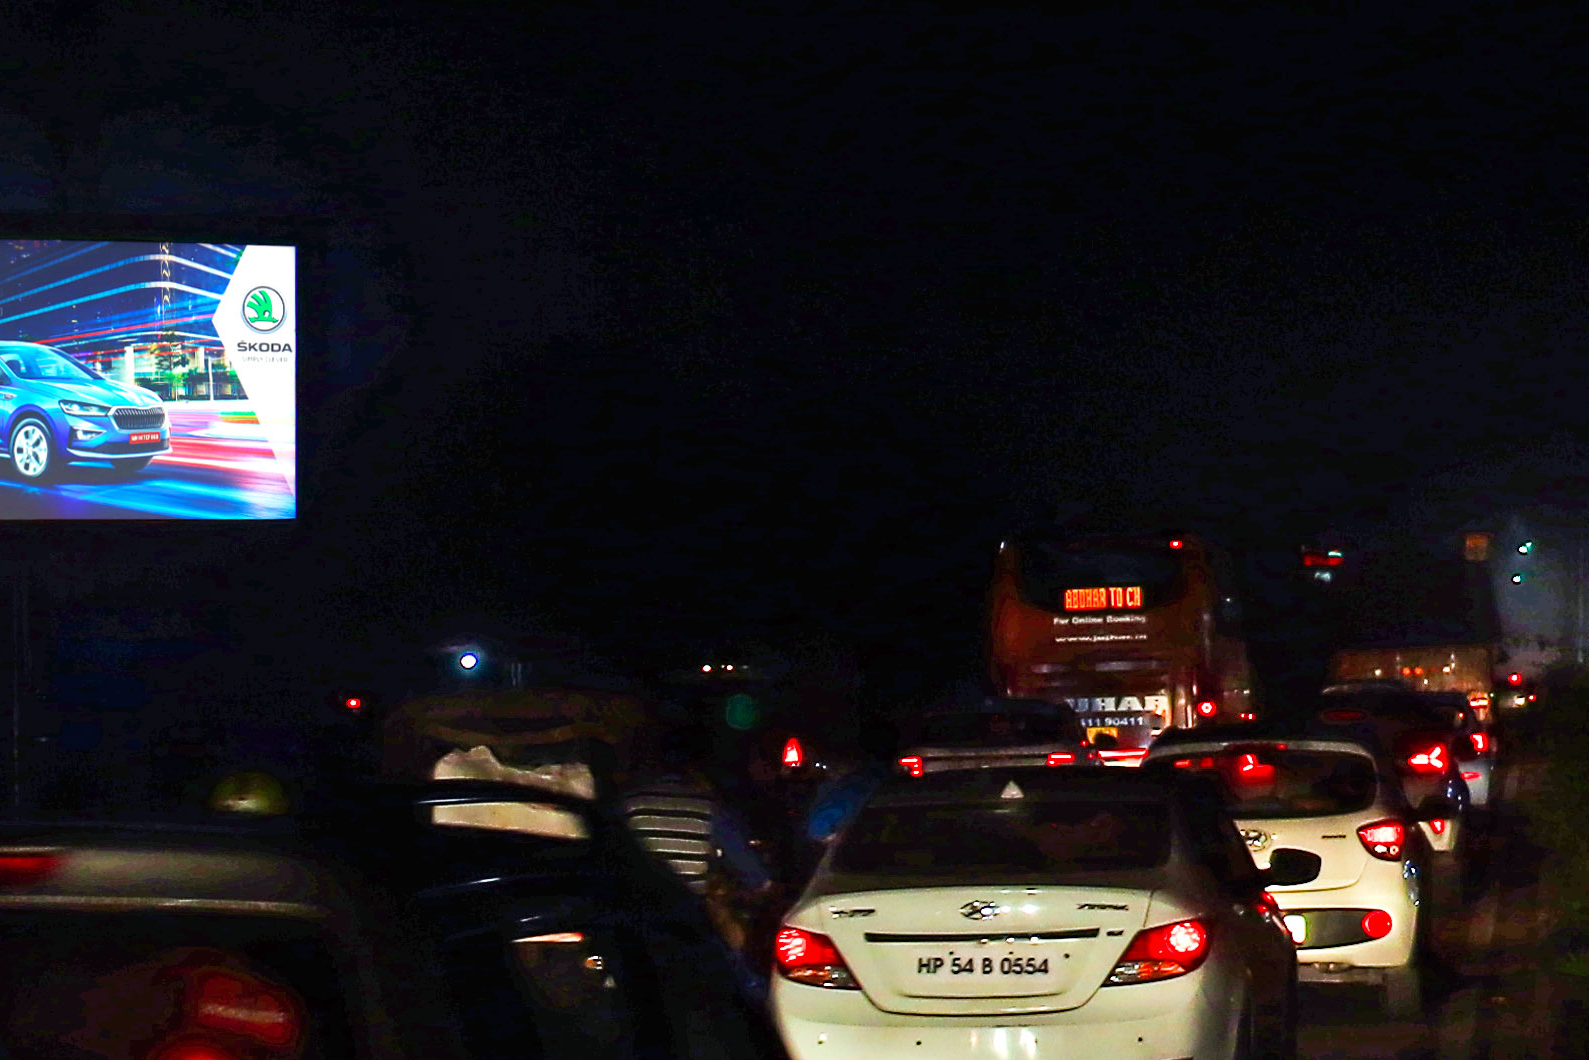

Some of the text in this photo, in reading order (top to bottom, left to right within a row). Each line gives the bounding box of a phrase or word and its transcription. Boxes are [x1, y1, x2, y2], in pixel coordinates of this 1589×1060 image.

[237, 340, 293, 353] ŠKODA
[1109, 587, 1123, 608] TO
[1125, 586, 1142, 607] CH
[1053, 617, 1069, 625] For
[1071, 616, 1104, 624] Online
[917, 957, 1049, 974] HP 54 B 0554
